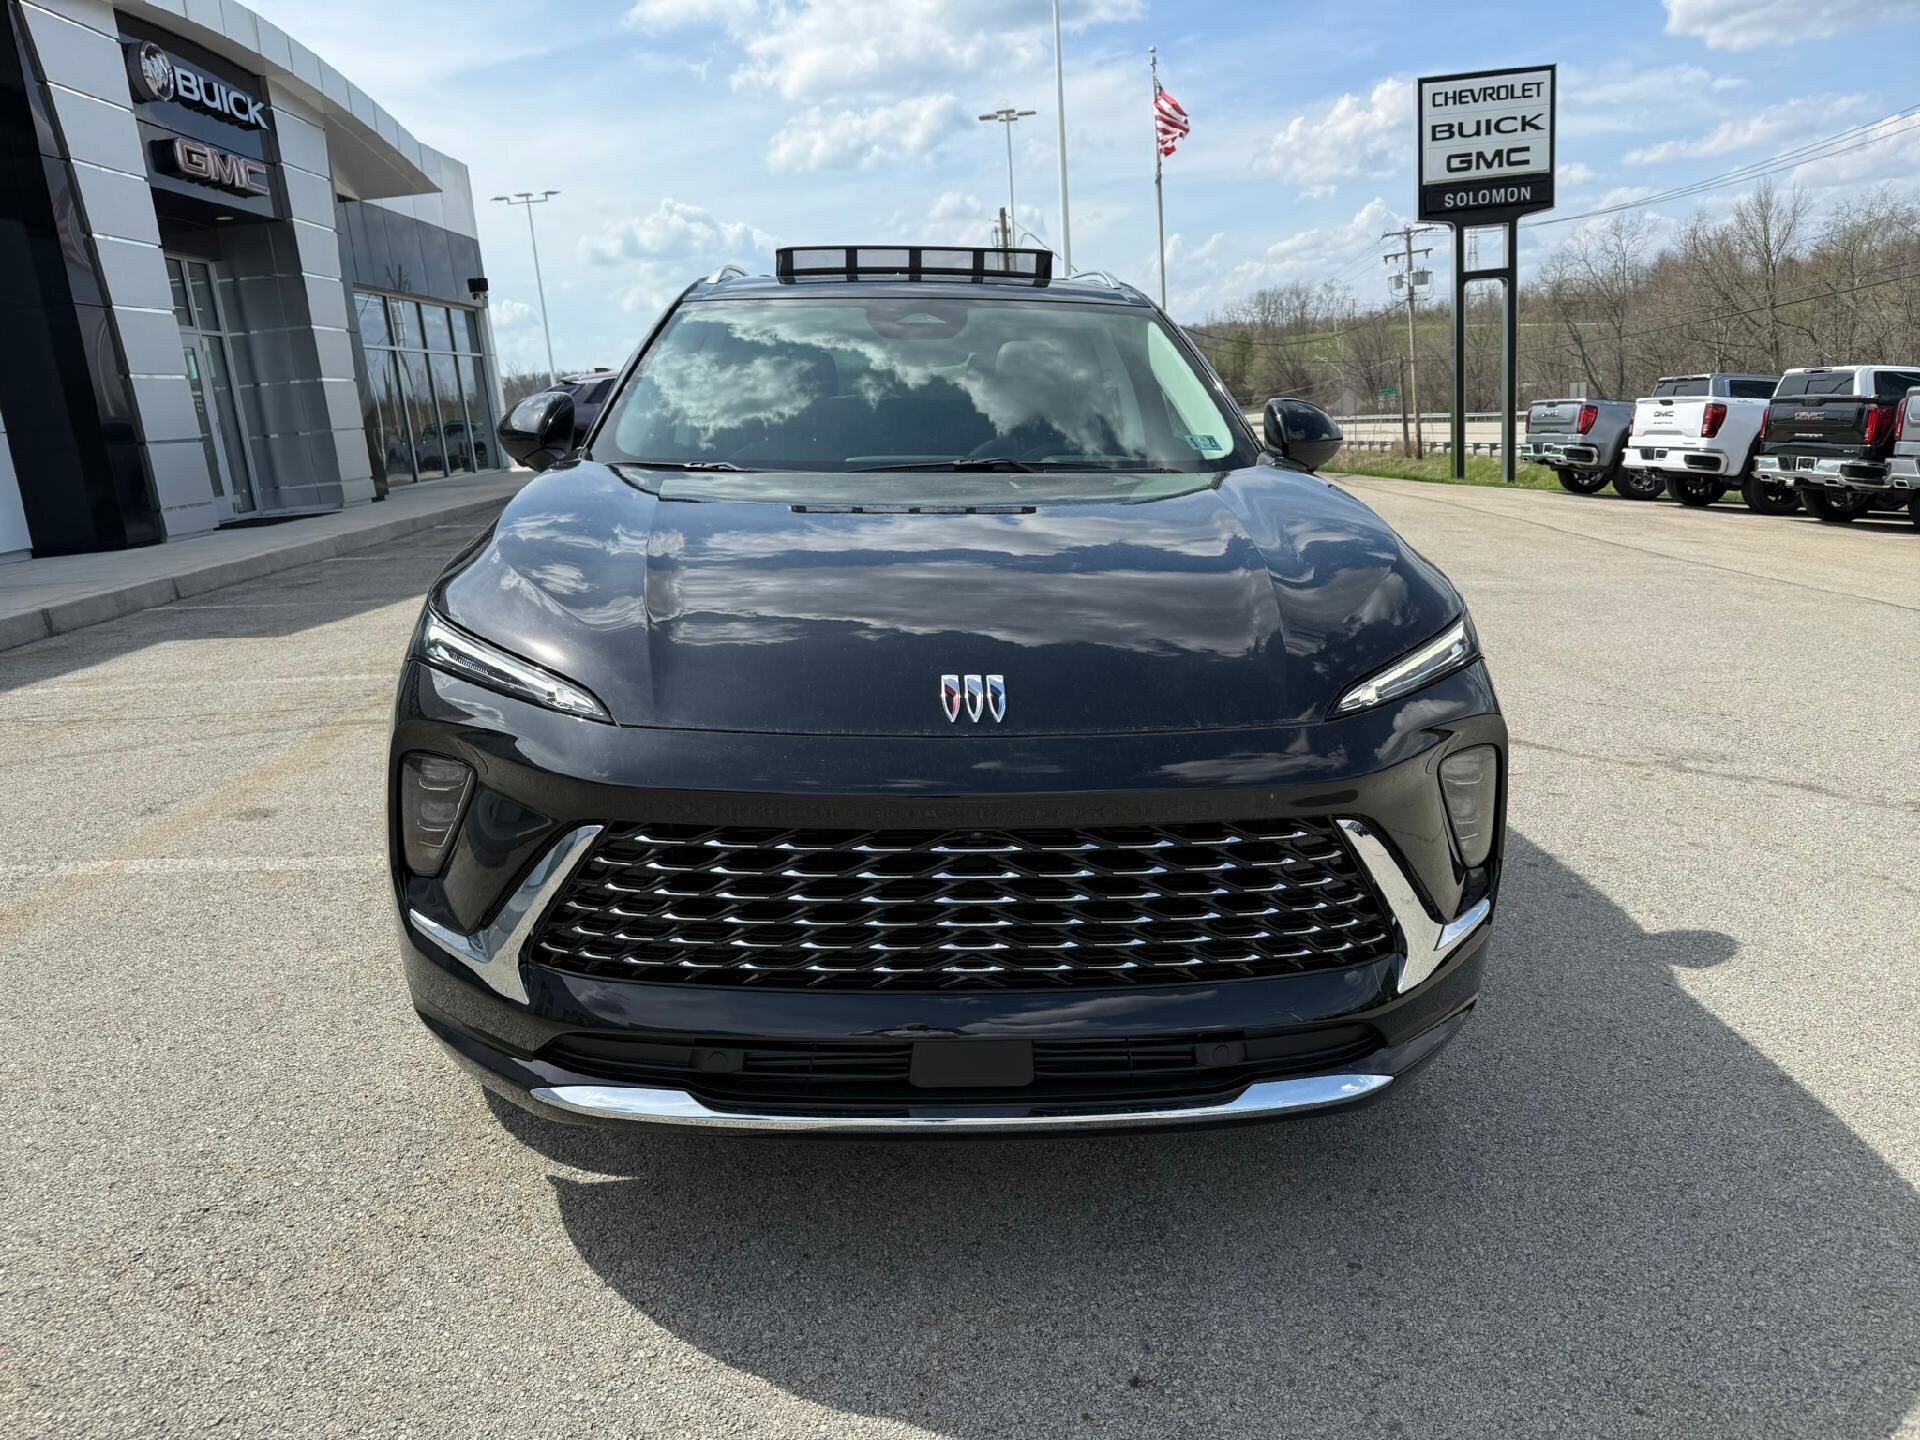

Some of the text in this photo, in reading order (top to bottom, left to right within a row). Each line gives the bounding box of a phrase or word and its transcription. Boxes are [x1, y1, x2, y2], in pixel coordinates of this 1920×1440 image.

[174, 67, 269, 129] BUICK
[1432, 82, 1544, 107] CHEVROLET
[1431, 113, 1545, 141] BUICK
[175, 137, 270, 196] GMC
[1447, 146, 1530, 173] GMC
[1444, 186, 1531, 207] SOLOMON
[1653, 410, 1675, 418] GMC
